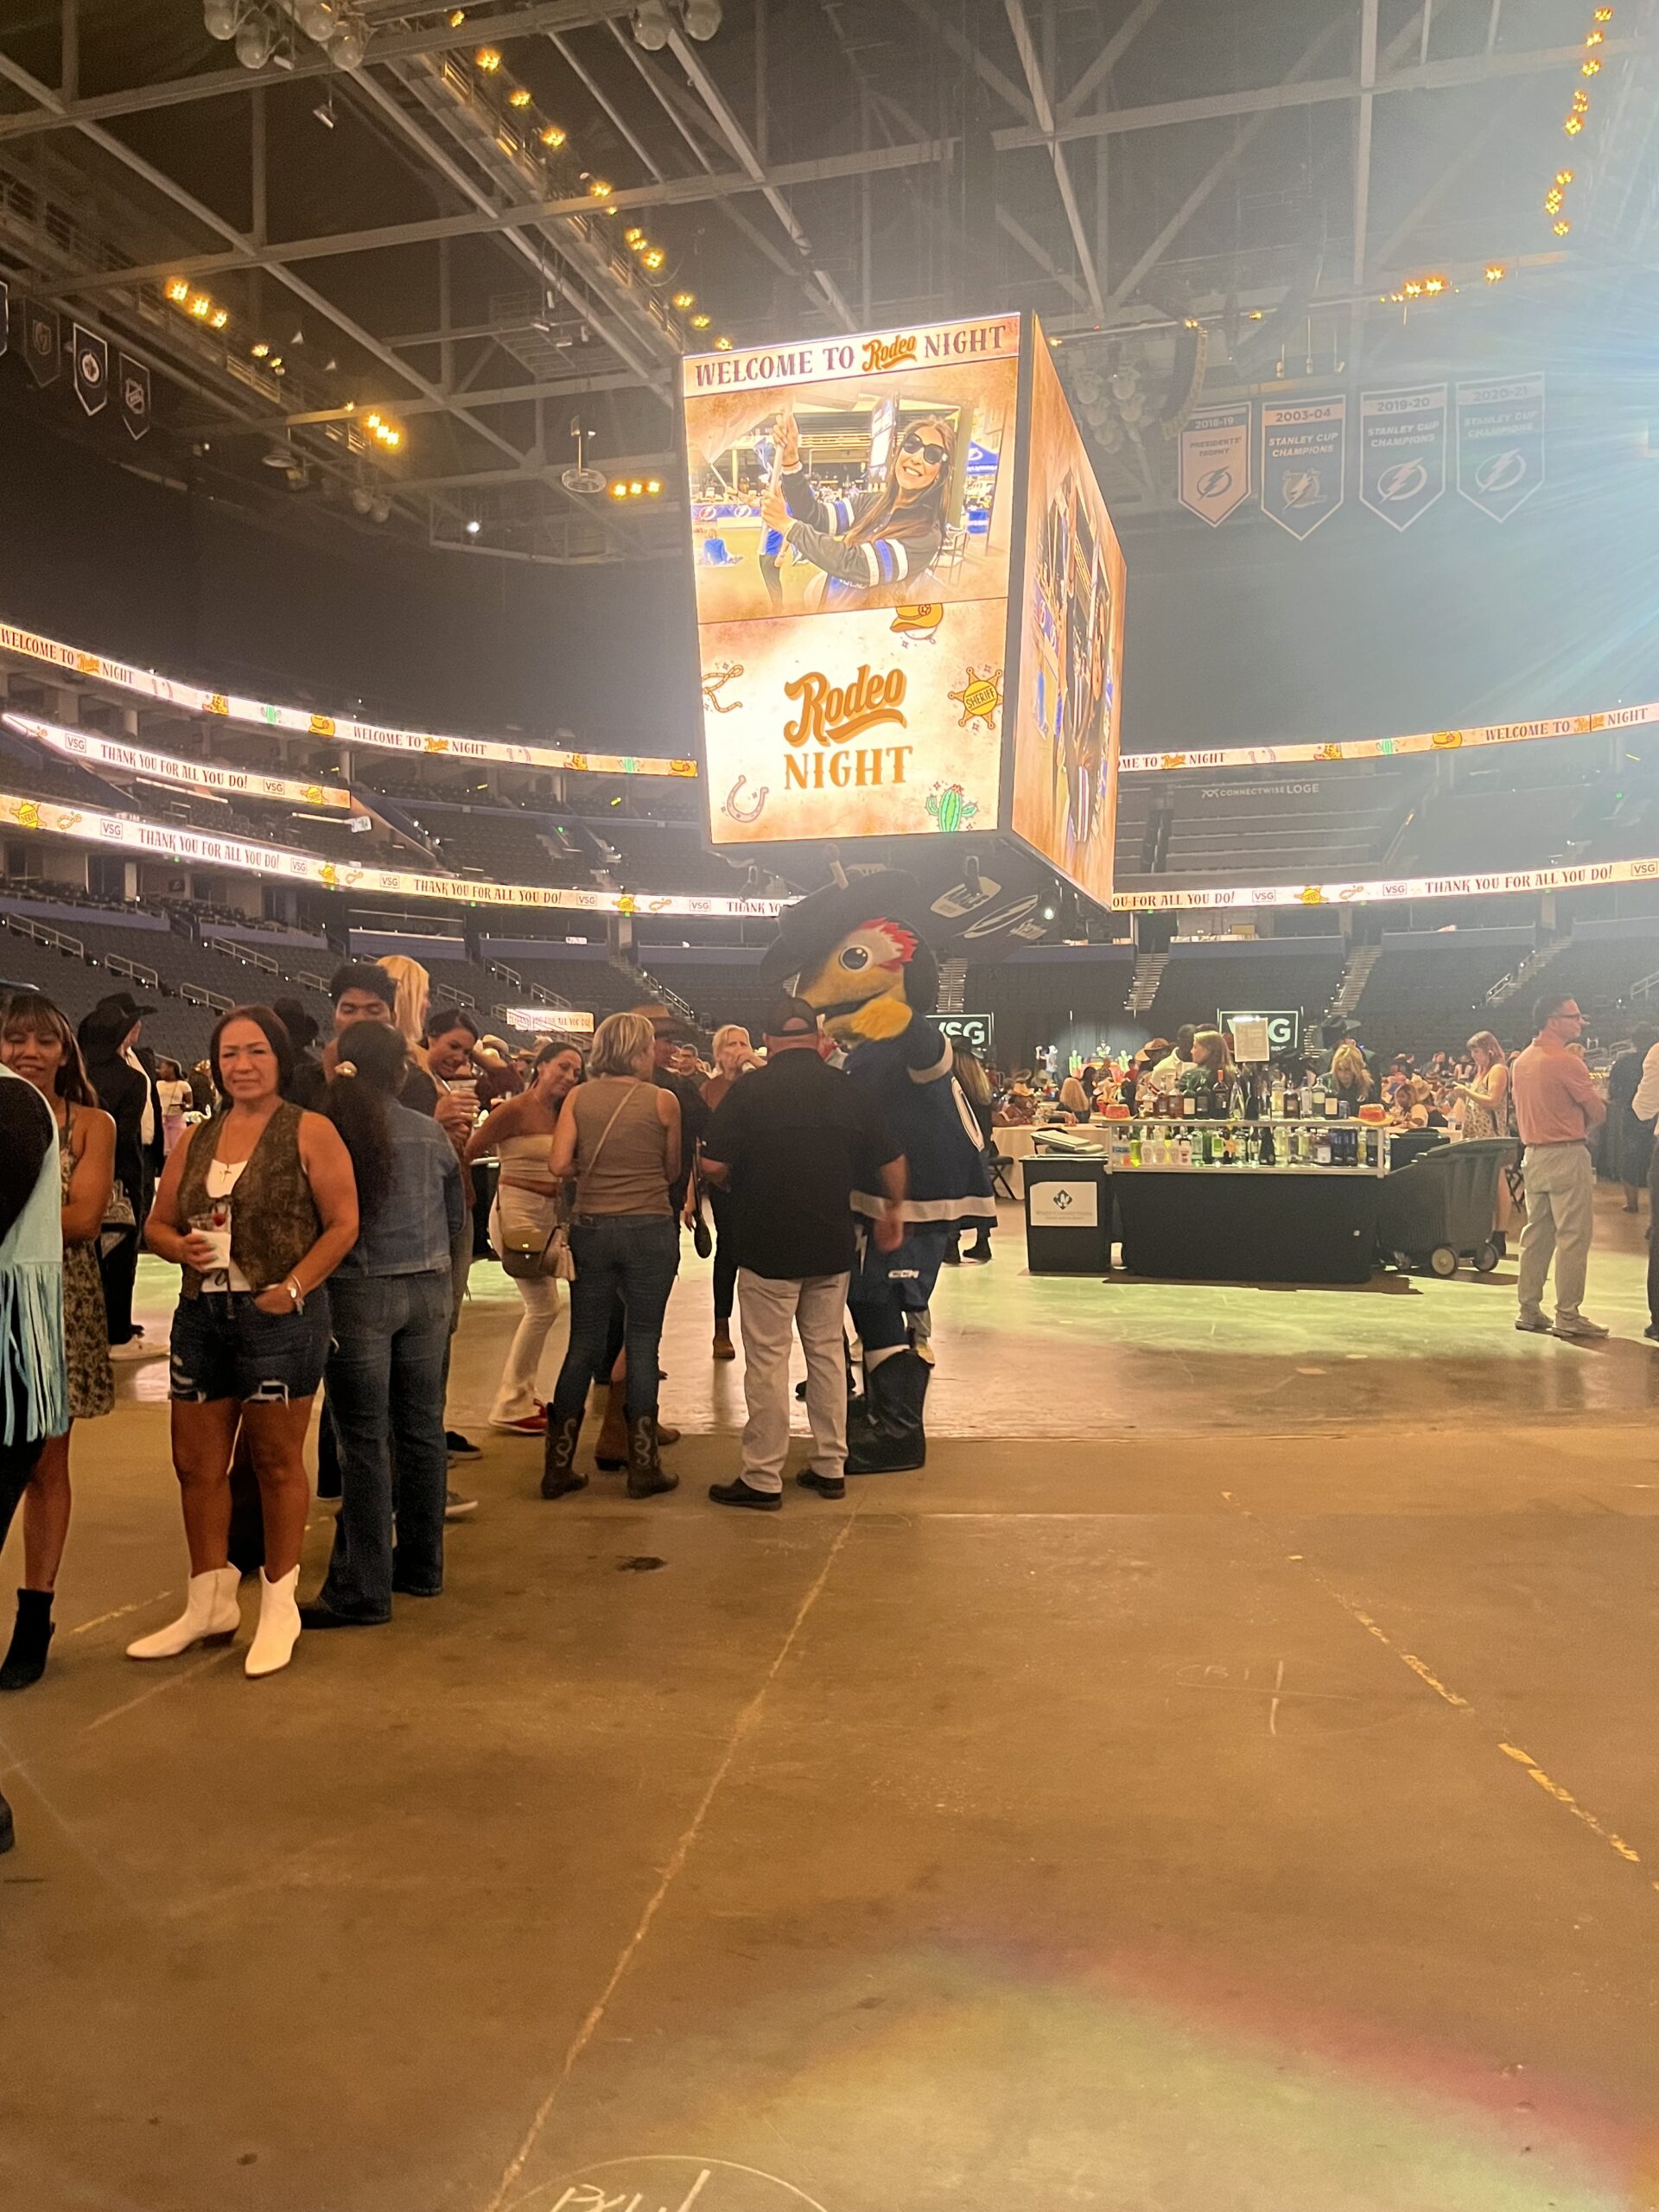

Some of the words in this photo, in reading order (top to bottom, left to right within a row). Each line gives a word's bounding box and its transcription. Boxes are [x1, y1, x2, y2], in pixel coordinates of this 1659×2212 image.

[695, 349, 813, 387] WELCOME
[823, 346, 855, 371] TO
[861, 334, 918, 372] Rodeo
[924, 325, 1007, 359] NIGHT
[1473, 385, 1529, 401] 2020-21
[1376, 397, 1431, 412] 2019-20
[1194, 416, 1235, 429] 2018-19
[1275, 408, 1332, 423] 2003-04
[1464, 414, 1510, 426] STANLEY
[1368, 424, 1414, 436] STANLEY
[1417, 420, 1440, 431] CUP
[1268, 434, 1314, 447] STANLEY
[1316, 432, 1338, 442] CUP
[1370, 433, 1435, 448] CHAMPIONS
[1272, 443, 1334, 457] CHAMPIONS
[1, 628, 56, 659] WELCOME
[60, 647, 74, 664] TO
[77, 652, 100, 673] Rodeo
[103, 661, 135, 683] NIGHT
[784, 664, 907, 747] Rodeo
[965, 687, 995, 709] SHERIFF
[1485, 722, 1548, 741] WELCOME
[1552, 721, 1570, 733] TO
[1607, 708, 1648, 726] NIGHT
[67, 736, 85, 750] VSG
[353, 726, 403, 746] WELCOME
[406, 734, 421, 747] TO
[423, 737, 449, 752] Rodeo
[452, 741, 487, 755] NIGHT
[101, 744, 137, 768] THANK
[139, 753, 157, 771] YOU
[160, 760, 180, 778] FOR
[181, 766, 199, 782] ALL
[202, 769, 224, 785] YOU
[228, 774, 248, 789] DO!
[1144, 757, 1158, 767] TO
[1160, 754, 1186, 768] Rodeo
[1189, 752, 1226, 765] NIGHT
[784, 746, 913, 790] NIGHT
[265, 782, 283, 792] VSG
[1287, 784, 1319, 794] LOGE
[103, 822, 122, 836] VSG
[138, 828, 176, 852] THANK
[180, 836, 199, 854] YOU
[201, 841, 222, 859] FOR
[225, 845, 242, 862] ALL
[245, 849, 261, 866] YOU
[264, 853, 280, 869] DO!
[292, 860, 307, 872] VSG
[1634, 863, 1656, 874] VSG
[382, 876, 398, 887] VSG
[1424, 878, 1470, 893] THANK
[1475, 876, 1499, 889] YOU
[1505, 874, 1530, 887] FOR
[1535, 872, 1559, 886] ALL
[1561, 868, 1586, 882] YOU
[1591, 866, 1612, 880] DO!
[413, 879, 448, 896] THANK
[452, 883, 469, 897] YOU
[473, 886, 492, 899] FOR
[494, 887, 515, 901] ALL
[519, 890, 539, 903] YOU
[543, 891, 562, 904] DO!
[1385, 884, 1405, 894] VSG
[578, 895, 595, 905] VSG
[1113, 896, 1128, 907] OU
[1133, 895, 1156, 906] FOR
[1160, 894, 1183, 906] ALL
[1186, 893, 1210, 905] YOU
[1214, 891, 1236, 904] DO!
[727, 901, 766, 914] THANK
[768, 903, 780, 913] YO
